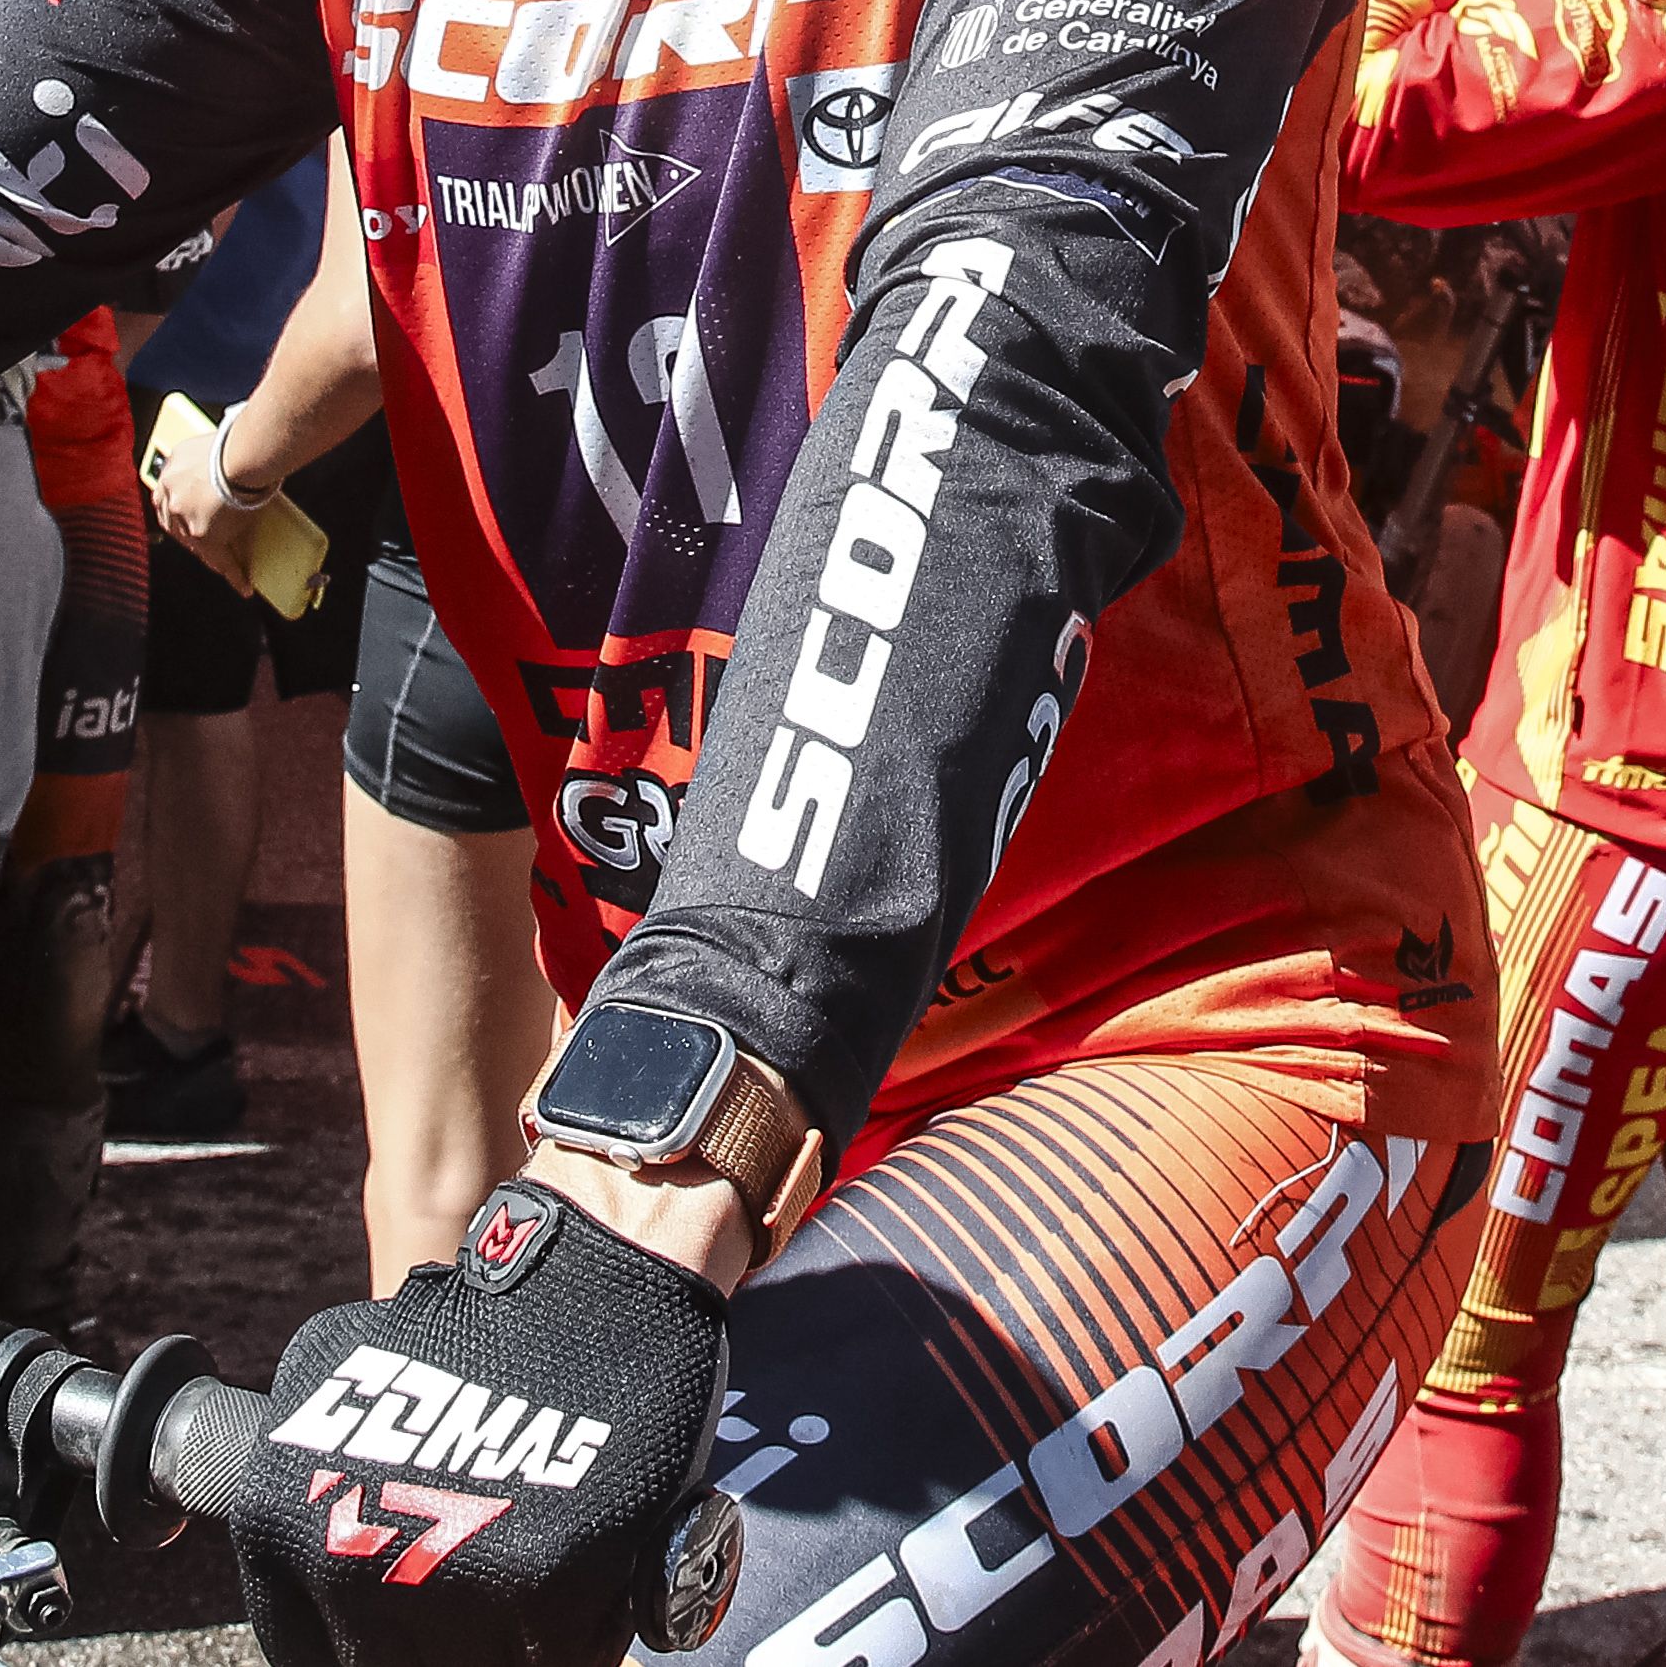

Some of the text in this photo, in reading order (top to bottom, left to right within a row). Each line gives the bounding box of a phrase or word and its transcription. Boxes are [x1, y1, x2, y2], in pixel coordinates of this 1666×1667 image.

[1001, 20, 1220, 91] de Catalunya
[737, 236, 1016, 901] SCORPA
[55, 676, 140, 738] iati
[267, 1344, 614, 1491] COMAS
[744, 1135, 1429, 1667] SCORP
